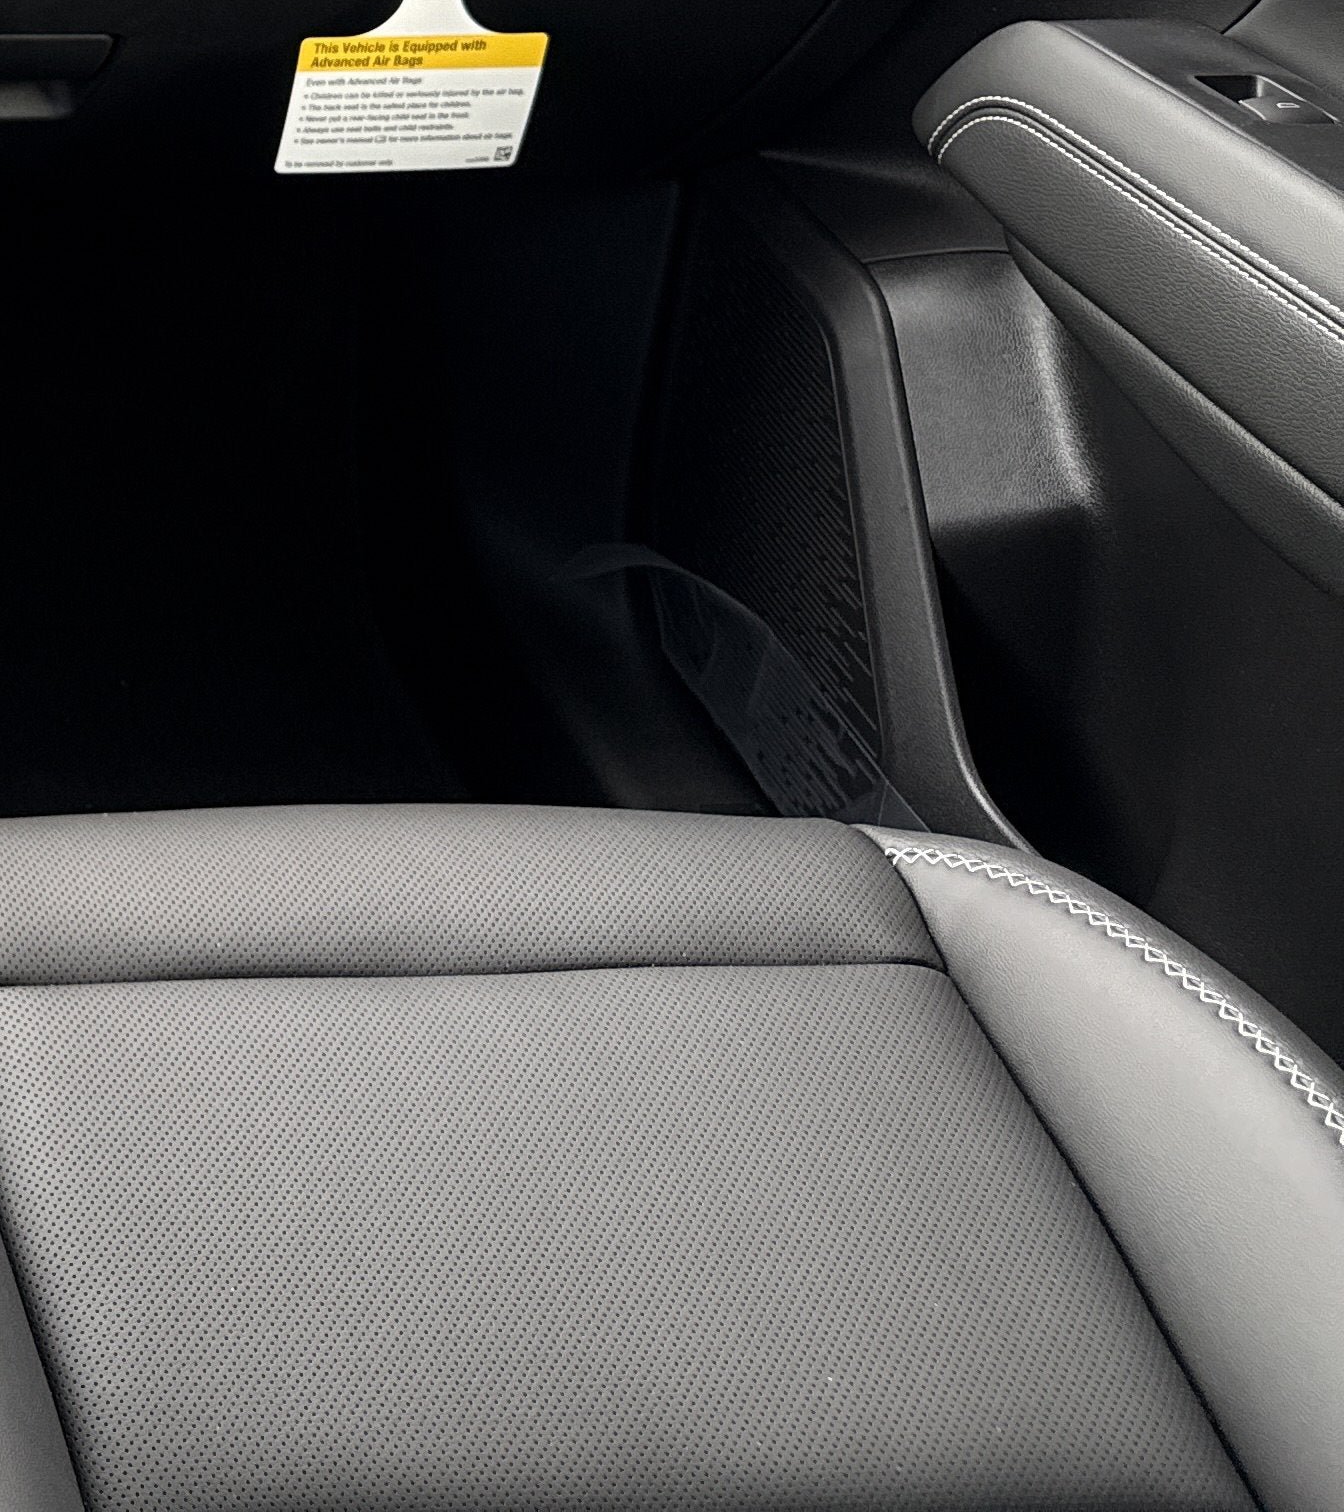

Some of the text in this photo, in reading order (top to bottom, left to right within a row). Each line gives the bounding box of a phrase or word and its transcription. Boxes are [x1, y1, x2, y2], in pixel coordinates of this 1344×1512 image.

[313, 39, 487, 54] This Vehicle is Equipped with
[311, 55, 423, 68] Advanced Air Bags
